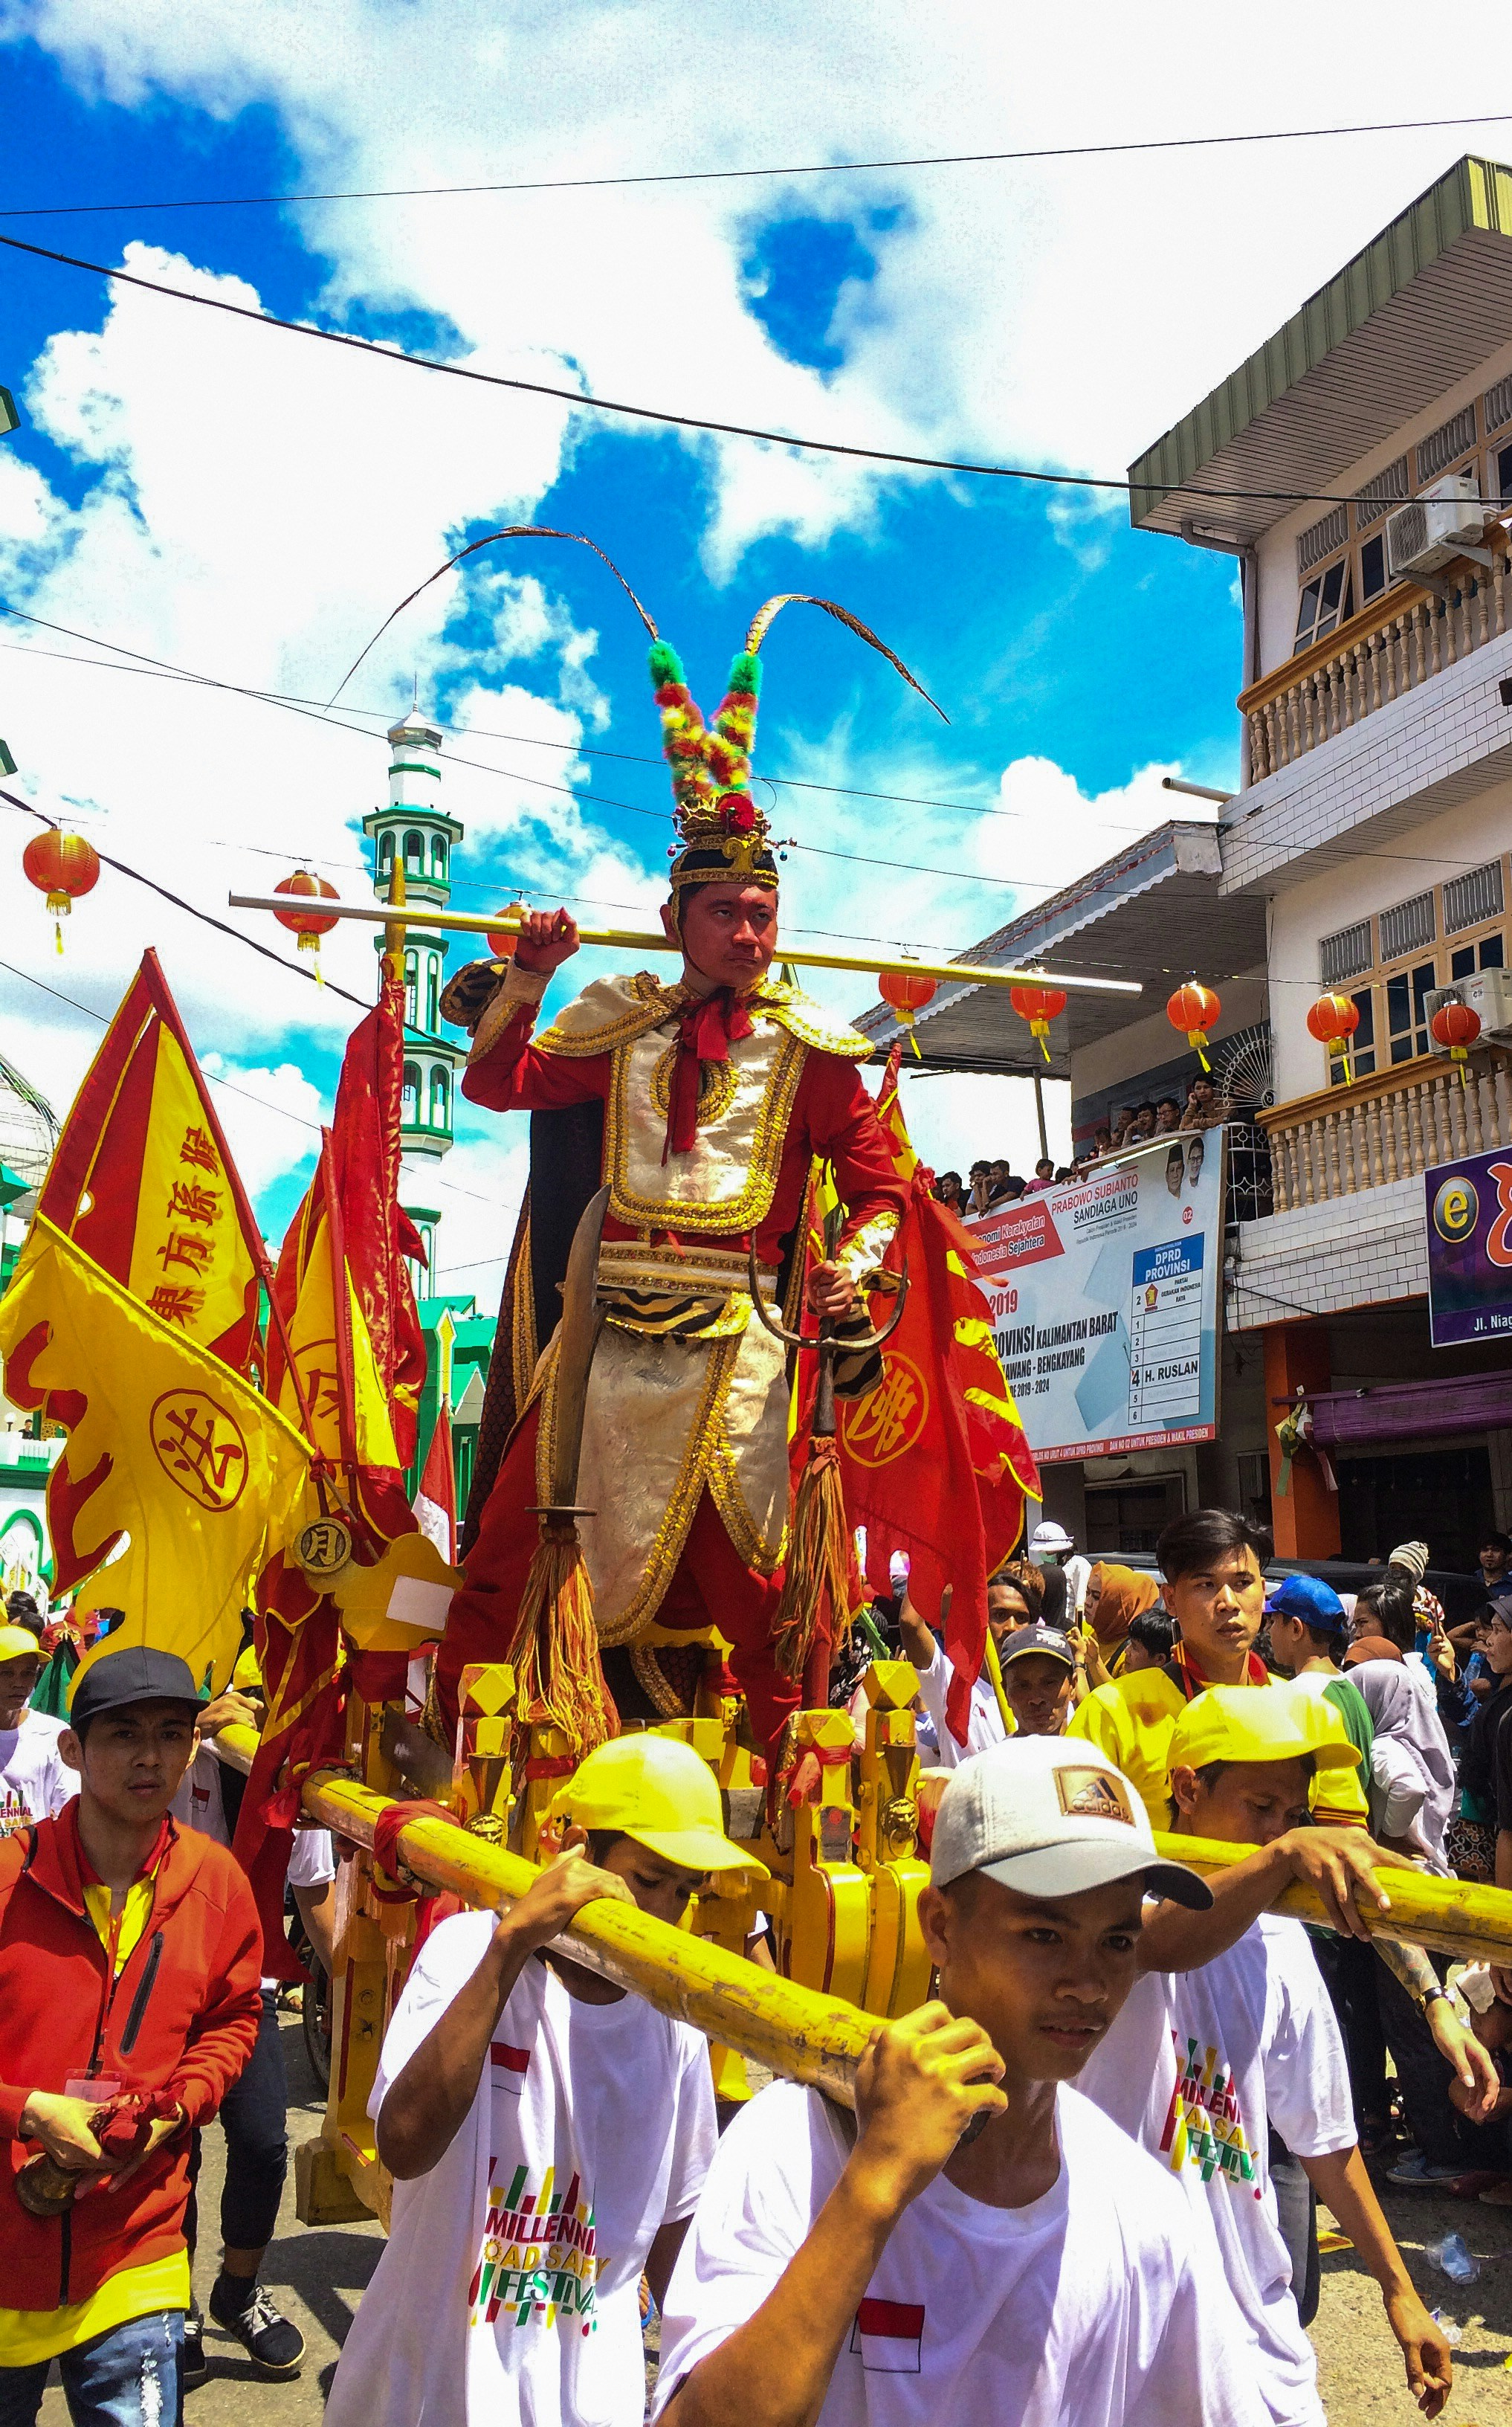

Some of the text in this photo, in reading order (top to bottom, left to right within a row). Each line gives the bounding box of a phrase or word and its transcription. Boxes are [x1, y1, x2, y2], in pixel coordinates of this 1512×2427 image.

[1052, 1174, 1138, 1215] PRABOWO SUBIANTO
[1073, 1190, 1138, 1224] SANDIAGA UNO
[1183, 1209, 1192, 1221] 02
[1001, 1215, 1045, 1240] Kerakyatan
[1008, 1234, 1044, 1257] Sejahtera
[1155, 1248, 1181, 1266] DPRD
[1146, 1259, 1190, 1282] PROVINSI
[989, 1289, 1018, 1316] 2019
[1136, 1295, 1141, 1306] 2
[992, 1324, 1036, 1358] ROVINSI
[1036, 1318, 1088, 1350] KALIMANTAN
[1089, 1311, 1119, 1338] BARAT
[1136, 1321, 1140, 1329] 1
[1473, 1317, 1487, 1331] Jl.
[1135, 1338, 1140, 1347] 2
[1037, 1347, 1085, 1375] BENGKAYANG
[1135, 1354, 1140, 1362] 3
[1132, 1360, 1198, 1387] 4 H. RUSLAN
[1017, 1382, 1031, 1398] 2019
[1035, 1378, 1050, 1394] 2024
[1133, 1394, 1138, 1403] 5
[1132, 1411, 1137, 1420] 6
[306, 1525, 340, 1566] 月
[484, 2207, 596, 2257] MILLENNI
